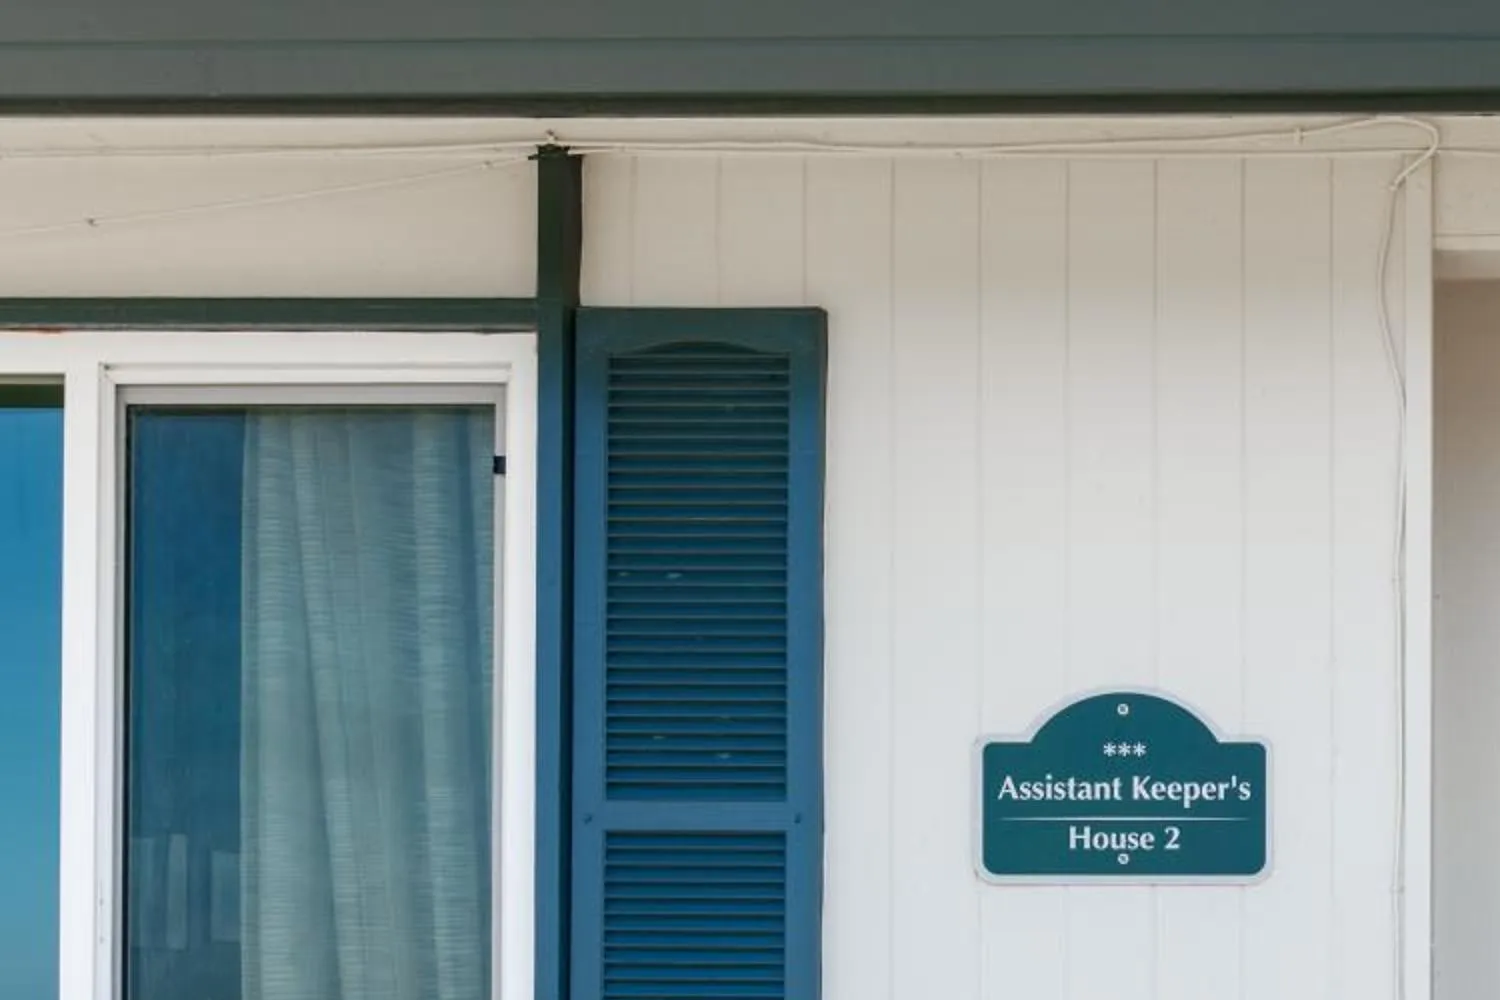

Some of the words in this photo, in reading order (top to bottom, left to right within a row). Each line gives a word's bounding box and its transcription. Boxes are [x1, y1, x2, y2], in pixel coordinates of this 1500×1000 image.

[998, 773, 1122, 800] Assistant
[1132, 775, 1251, 808] Keeper's
[1069, 826, 1155, 850] House
[1164, 826, 1180, 850] 2
